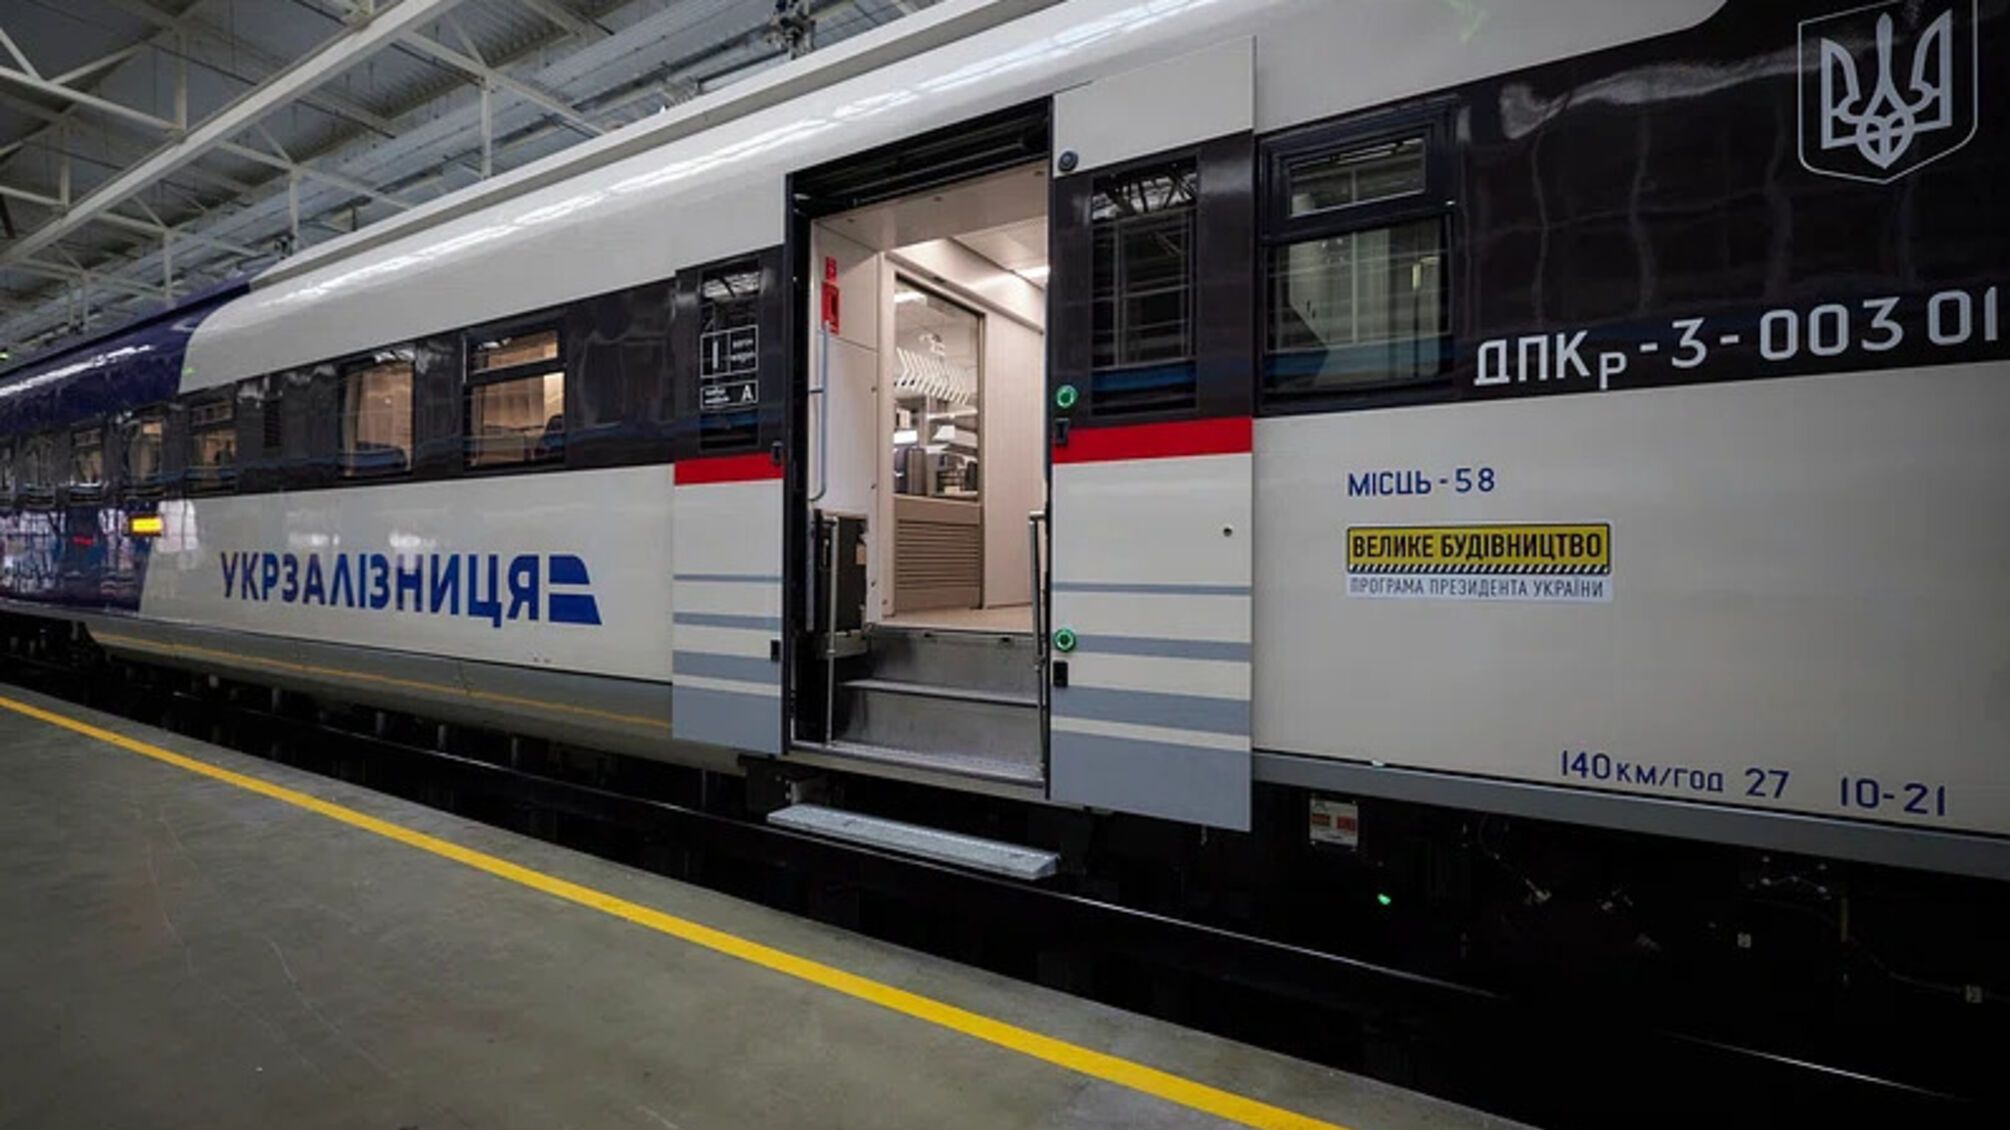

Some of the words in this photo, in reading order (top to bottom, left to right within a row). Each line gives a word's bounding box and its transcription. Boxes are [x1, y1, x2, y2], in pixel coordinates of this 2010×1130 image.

[1352, 535, 1434, 558] ВЕЛИКЕ
[1440, 532, 1601, 560] БУДІВНИЦТВО
[220, 551, 540, 629] УКРЗАЛІЗНИЦЯ
[1350, 576, 1424, 595] ПРОГРАМА
[1430, 577, 1529, 598] ПРЕЗИДЕНТА
[1533, 575, 1604, 598] УКРАЇНИ
[1745, 768, 1790, 799] 27
